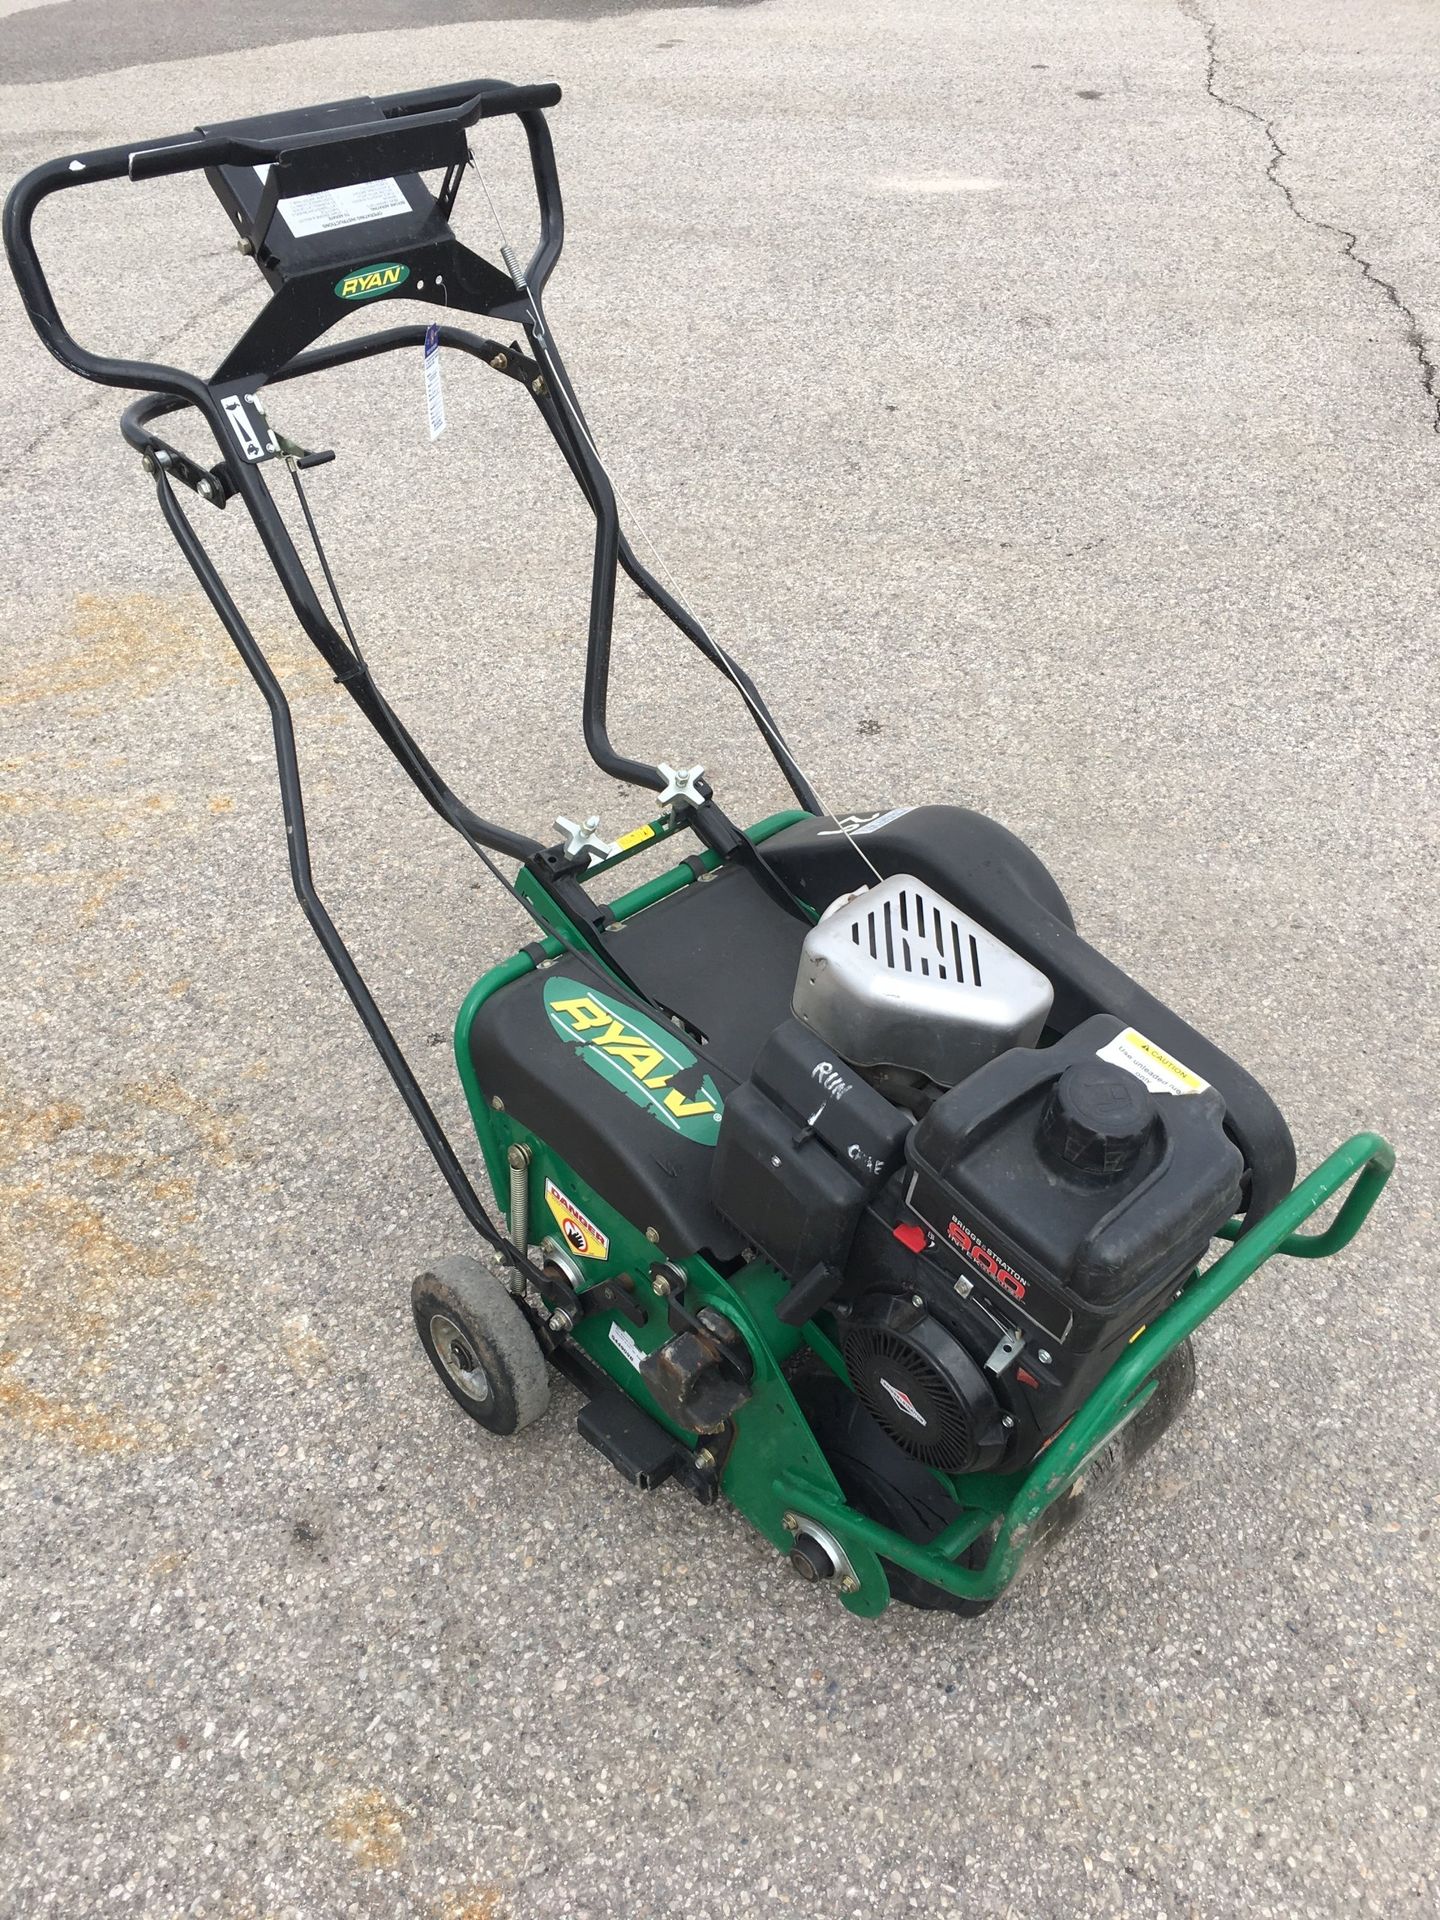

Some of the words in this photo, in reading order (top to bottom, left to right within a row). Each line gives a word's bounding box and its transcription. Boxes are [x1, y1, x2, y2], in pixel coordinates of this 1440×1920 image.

[342, 267, 401, 297] RYAN
[550, 997, 716, 1117] RYAN
[1118, 1045, 1133, 1060] Use
[1133, 1059, 1169, 1086] unleaded
[1151, 1050, 1188, 1079] CAUTION
[811, 1061, 853, 1100] RUN
[1135, 1071, 1152, 1085] only
[551, 1186, 605, 1245] DANGER
[949, 1221, 1026, 1299] 900
[952, 1214, 982, 1246] BRIGGS
[986, 1248, 1027, 1286] STRATTON
